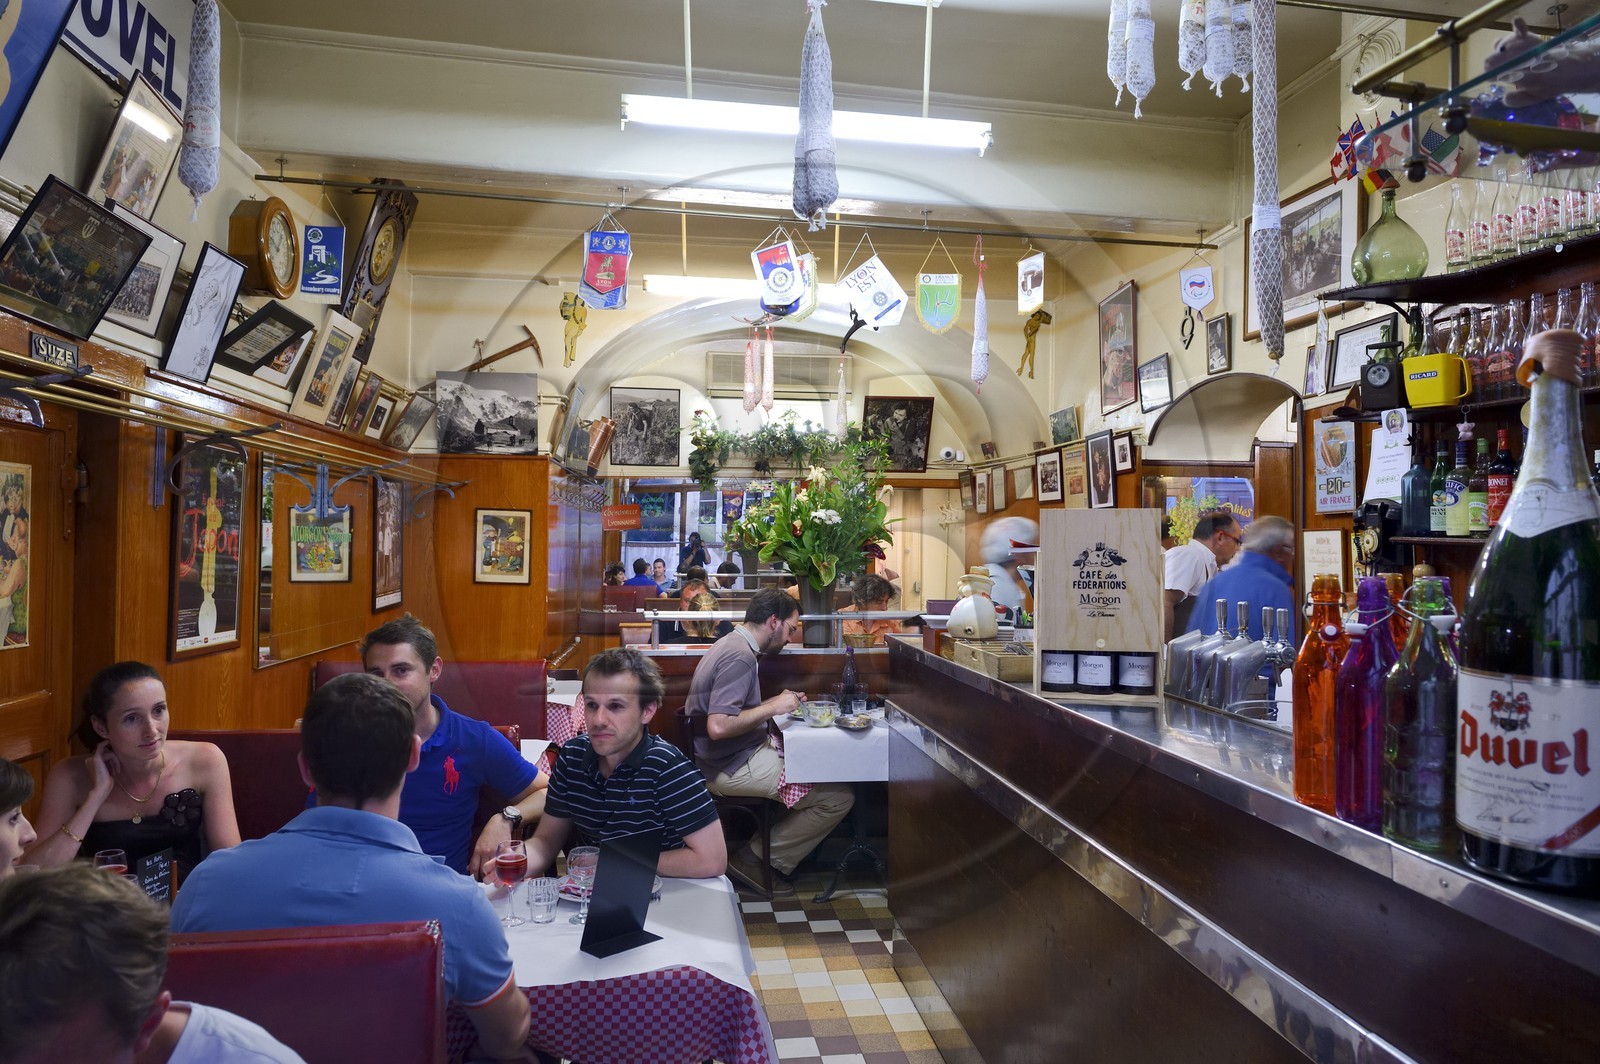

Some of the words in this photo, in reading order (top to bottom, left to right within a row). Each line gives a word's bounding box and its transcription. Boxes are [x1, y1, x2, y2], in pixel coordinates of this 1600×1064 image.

[846, 262, 877, 288] LYON
[857, 274, 877, 293] EST
[39, 336, 73, 362] SUZE
[1409, 371, 1438, 380] RICARD
[1327, 477, 1343, 495] 20
[1319, 497, 1328, 505] AIR
[1330, 496, 1352, 504] FRANCE
[178, 508, 240, 576] Japon
[1079, 570, 1102, 580] CAFÉ
[1105, 571, 1118, 580] des
[1073, 580, 1127, 590] FÉDÉRATIONS
[1080, 593, 1121, 606] Morgon
[1046, 660, 1068, 668] Morgon
[1081, 661, 1104, 669] Morgon
[1127, 662, 1151, 670] Morgon
[1460, 709, 1592, 777] Duvel
